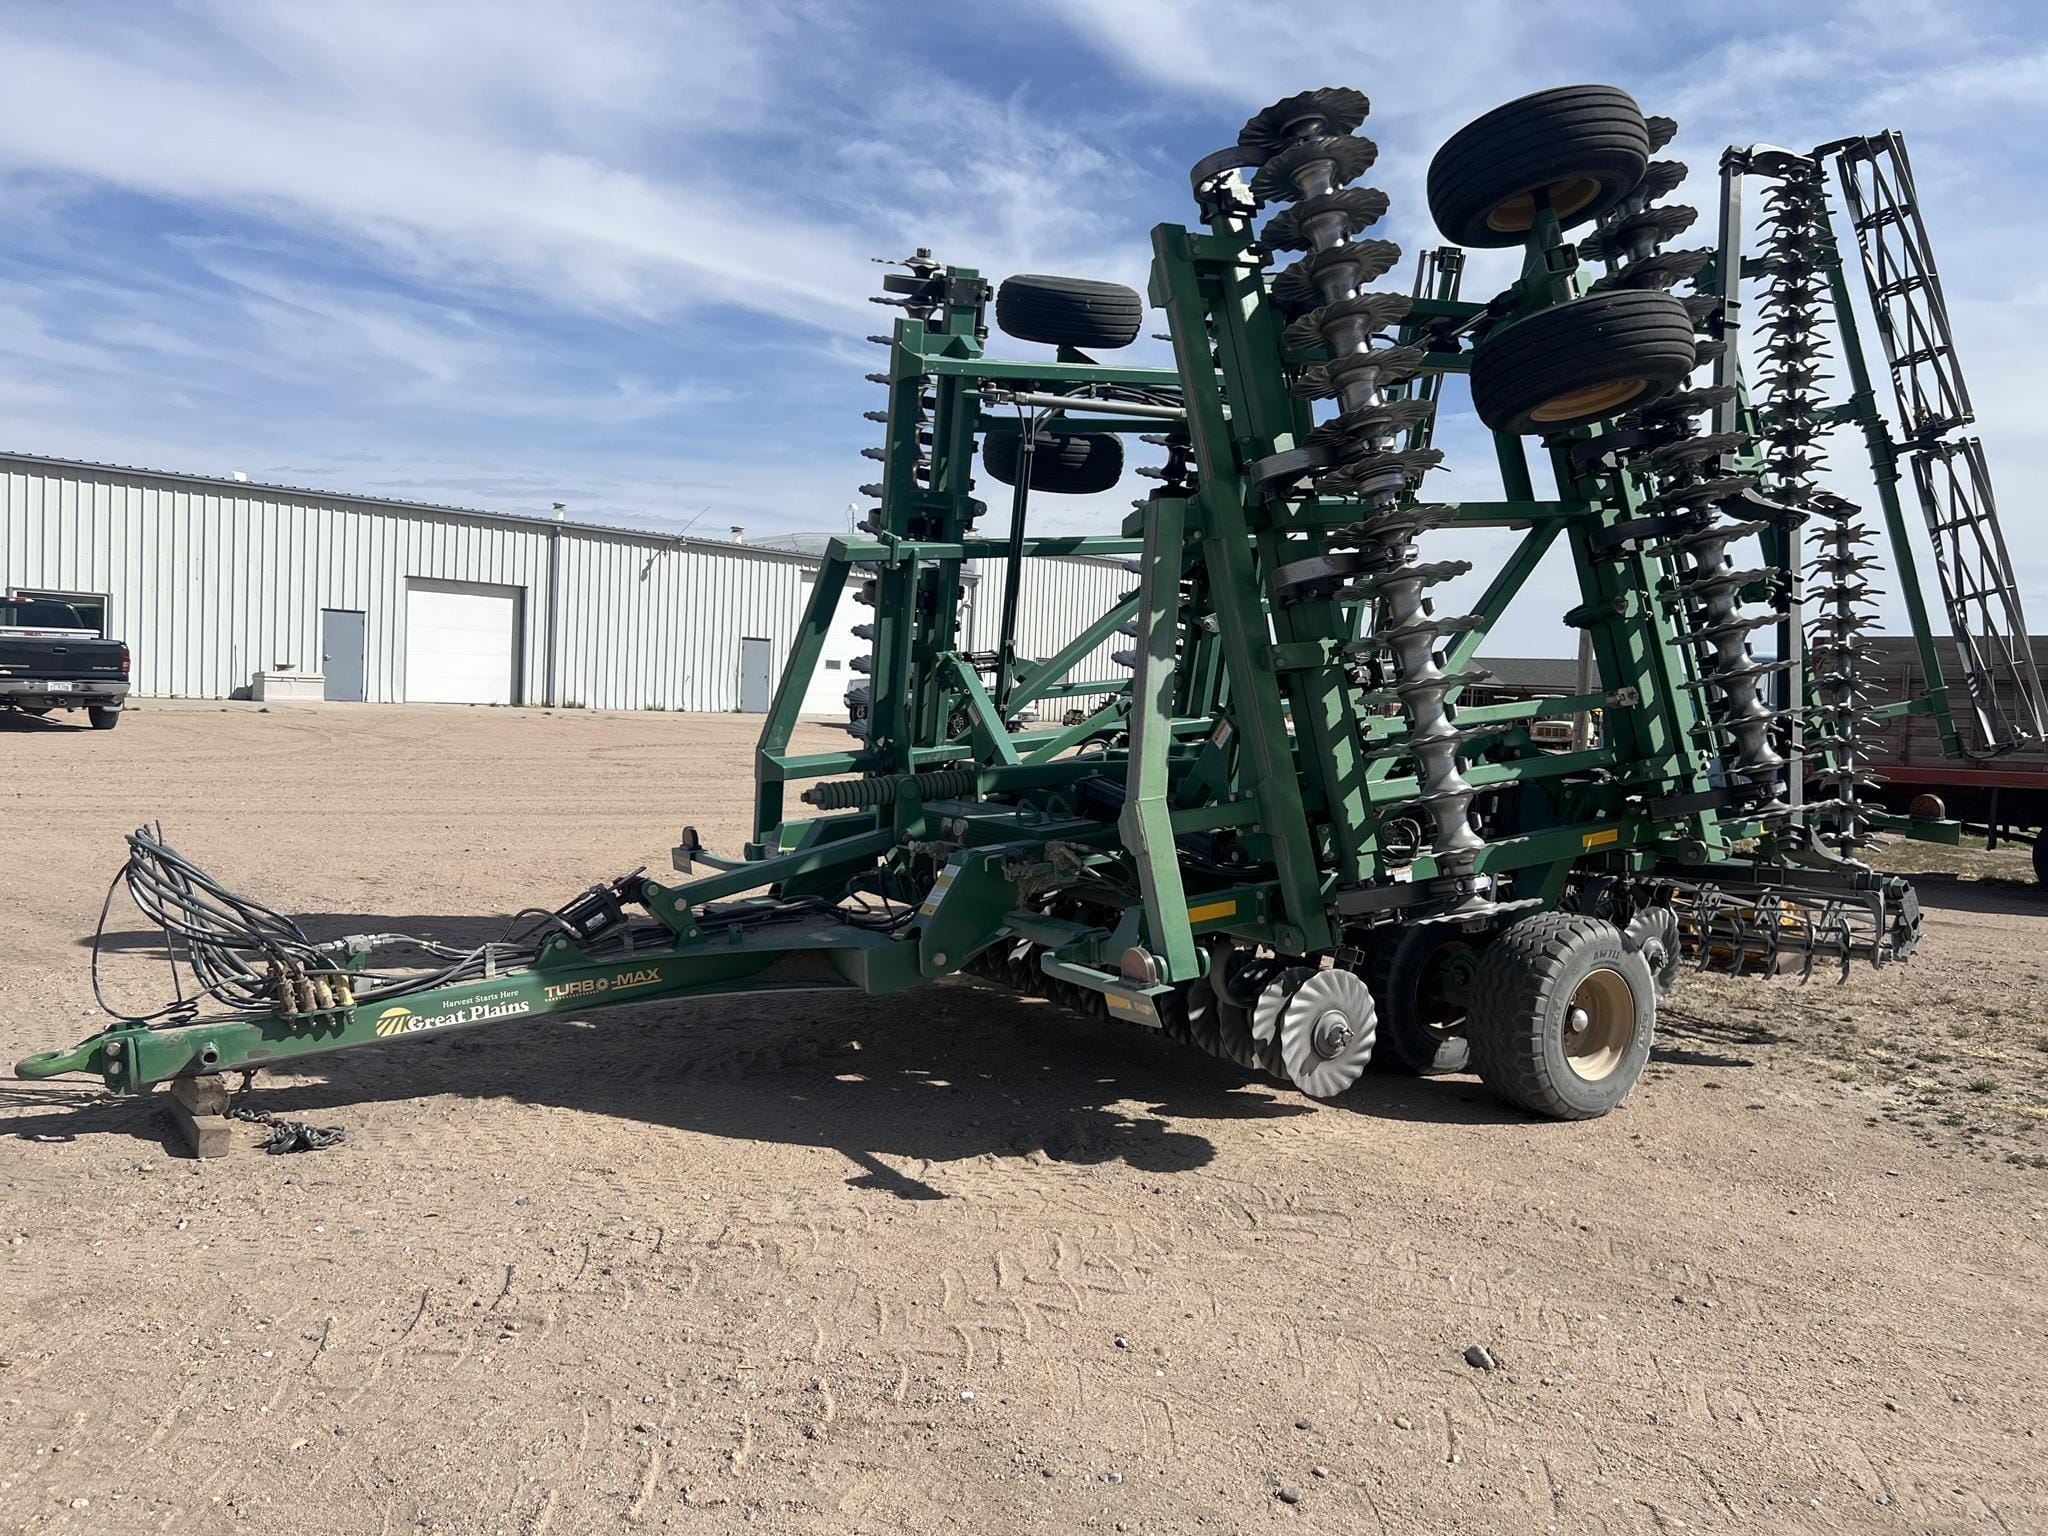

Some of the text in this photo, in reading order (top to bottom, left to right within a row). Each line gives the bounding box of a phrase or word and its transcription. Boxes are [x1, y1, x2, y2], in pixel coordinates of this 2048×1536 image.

[443, 990, 519, 1008] Harvest Starts Here
[407, 1001, 530, 1031] Great Plains
